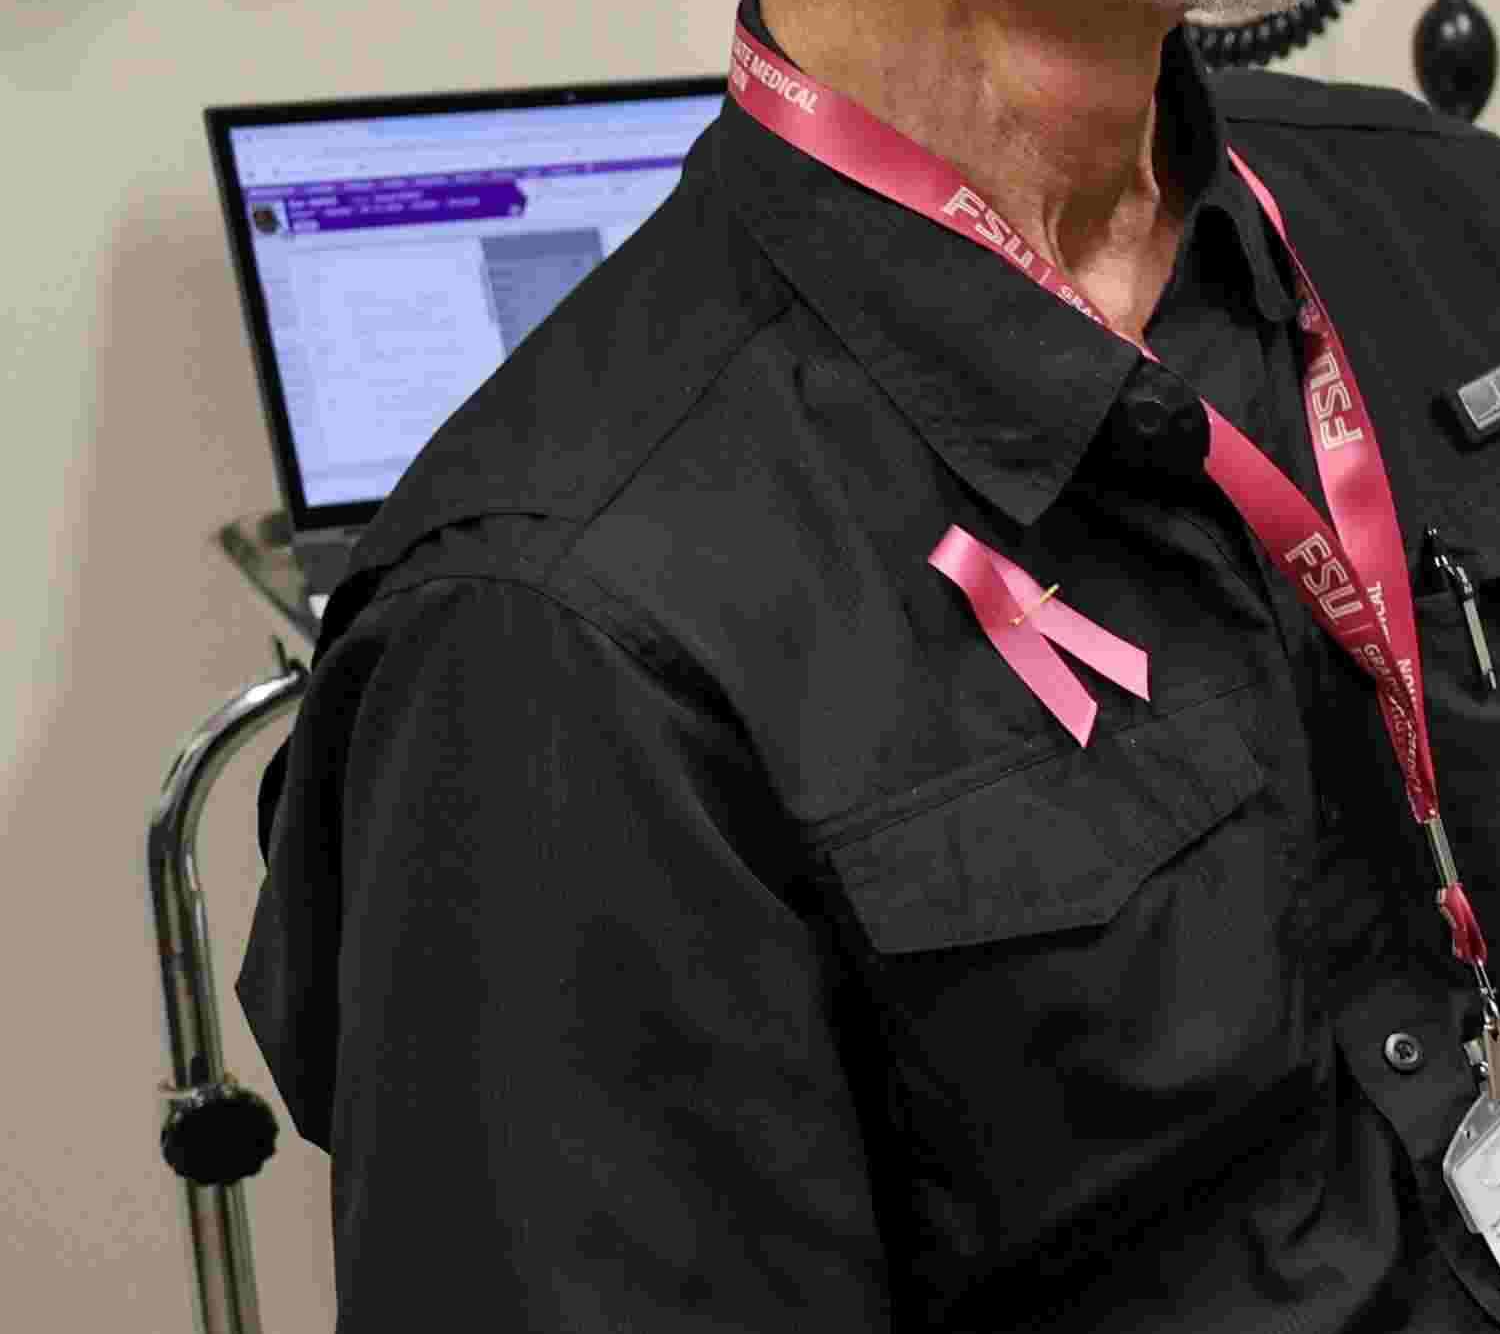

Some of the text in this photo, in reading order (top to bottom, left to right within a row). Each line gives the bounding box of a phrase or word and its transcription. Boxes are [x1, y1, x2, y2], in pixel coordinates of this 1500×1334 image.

[751, 54, 819, 114] MEDICAL
[941, 185, 1034, 268] FSU
[1311, 351, 1363, 451] FSU
[1284, 532, 1363, 619] FSU
